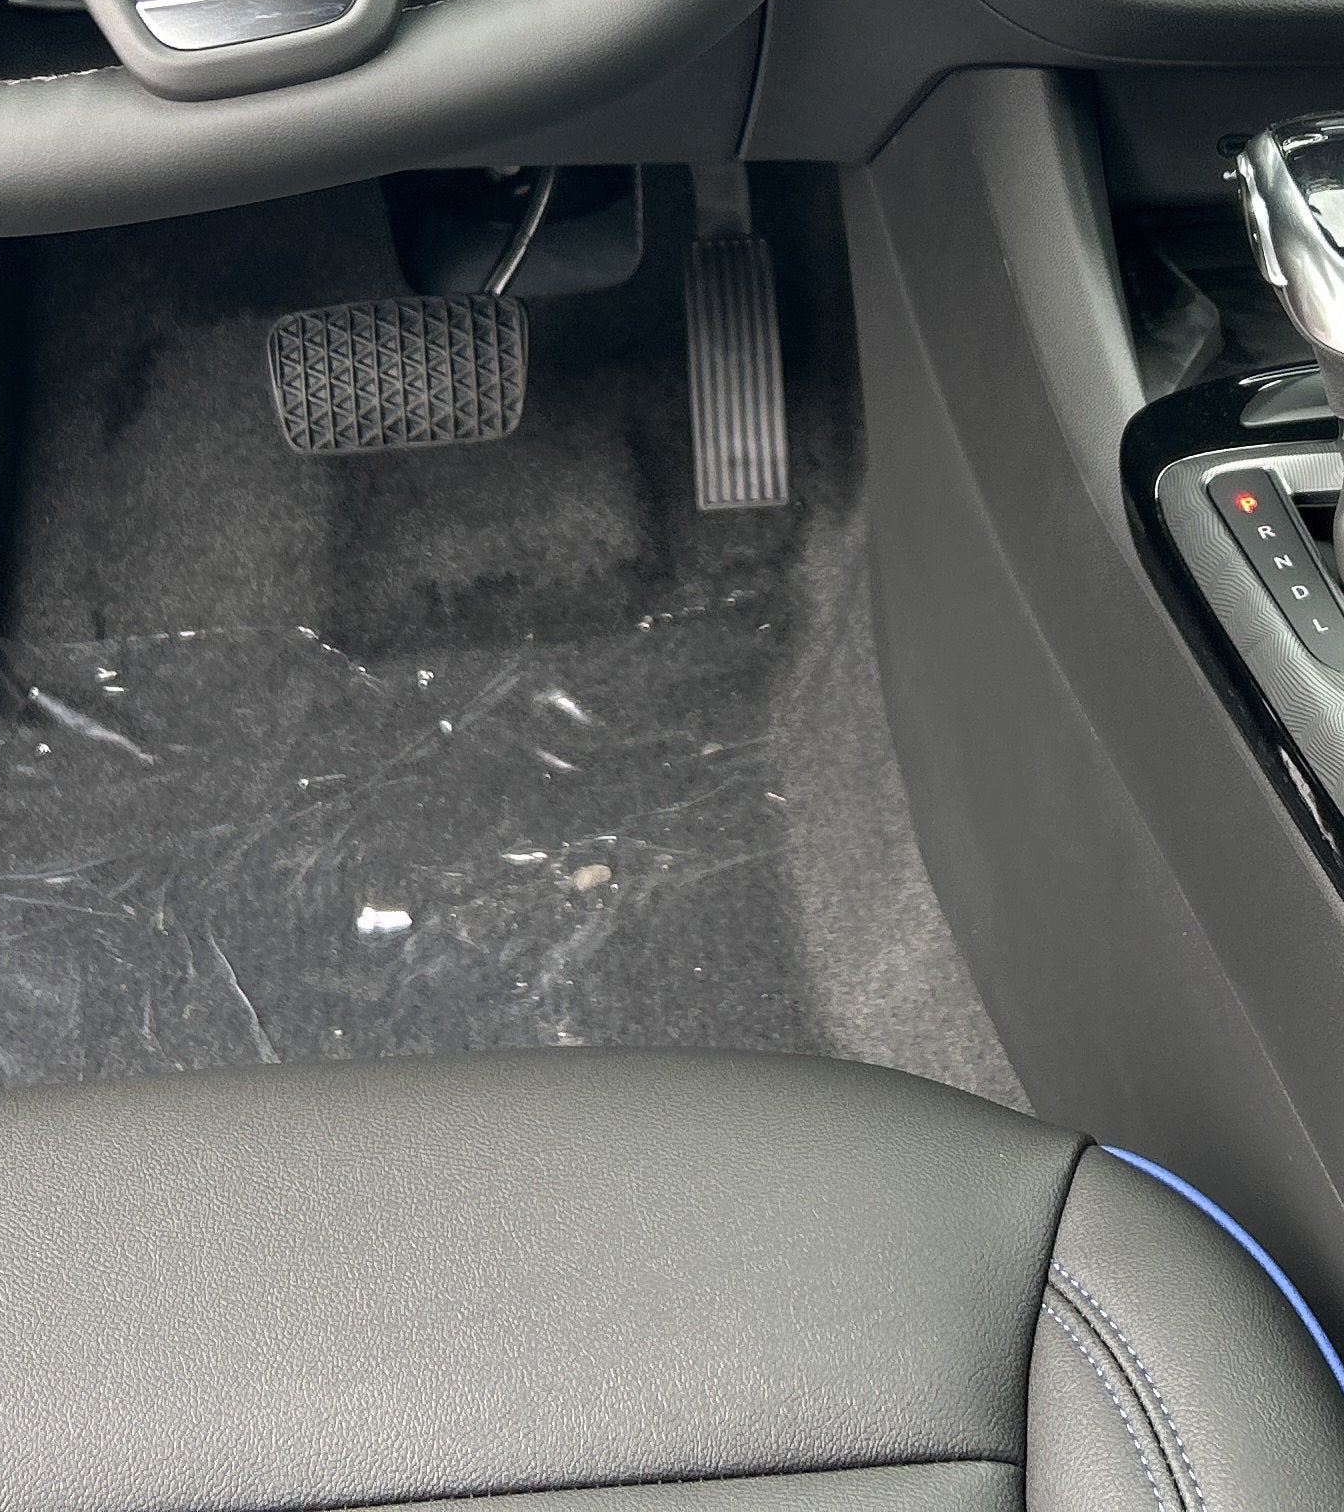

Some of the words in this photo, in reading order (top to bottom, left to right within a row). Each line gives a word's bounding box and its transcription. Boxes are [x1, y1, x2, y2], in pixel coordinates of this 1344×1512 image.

[1240, 496, 1257, 513] P
[1257, 525, 1276, 539] R
[1273, 554, 1294, 569] N
[1291, 585, 1309, 600] D
[1312, 618, 1328, 632] L
